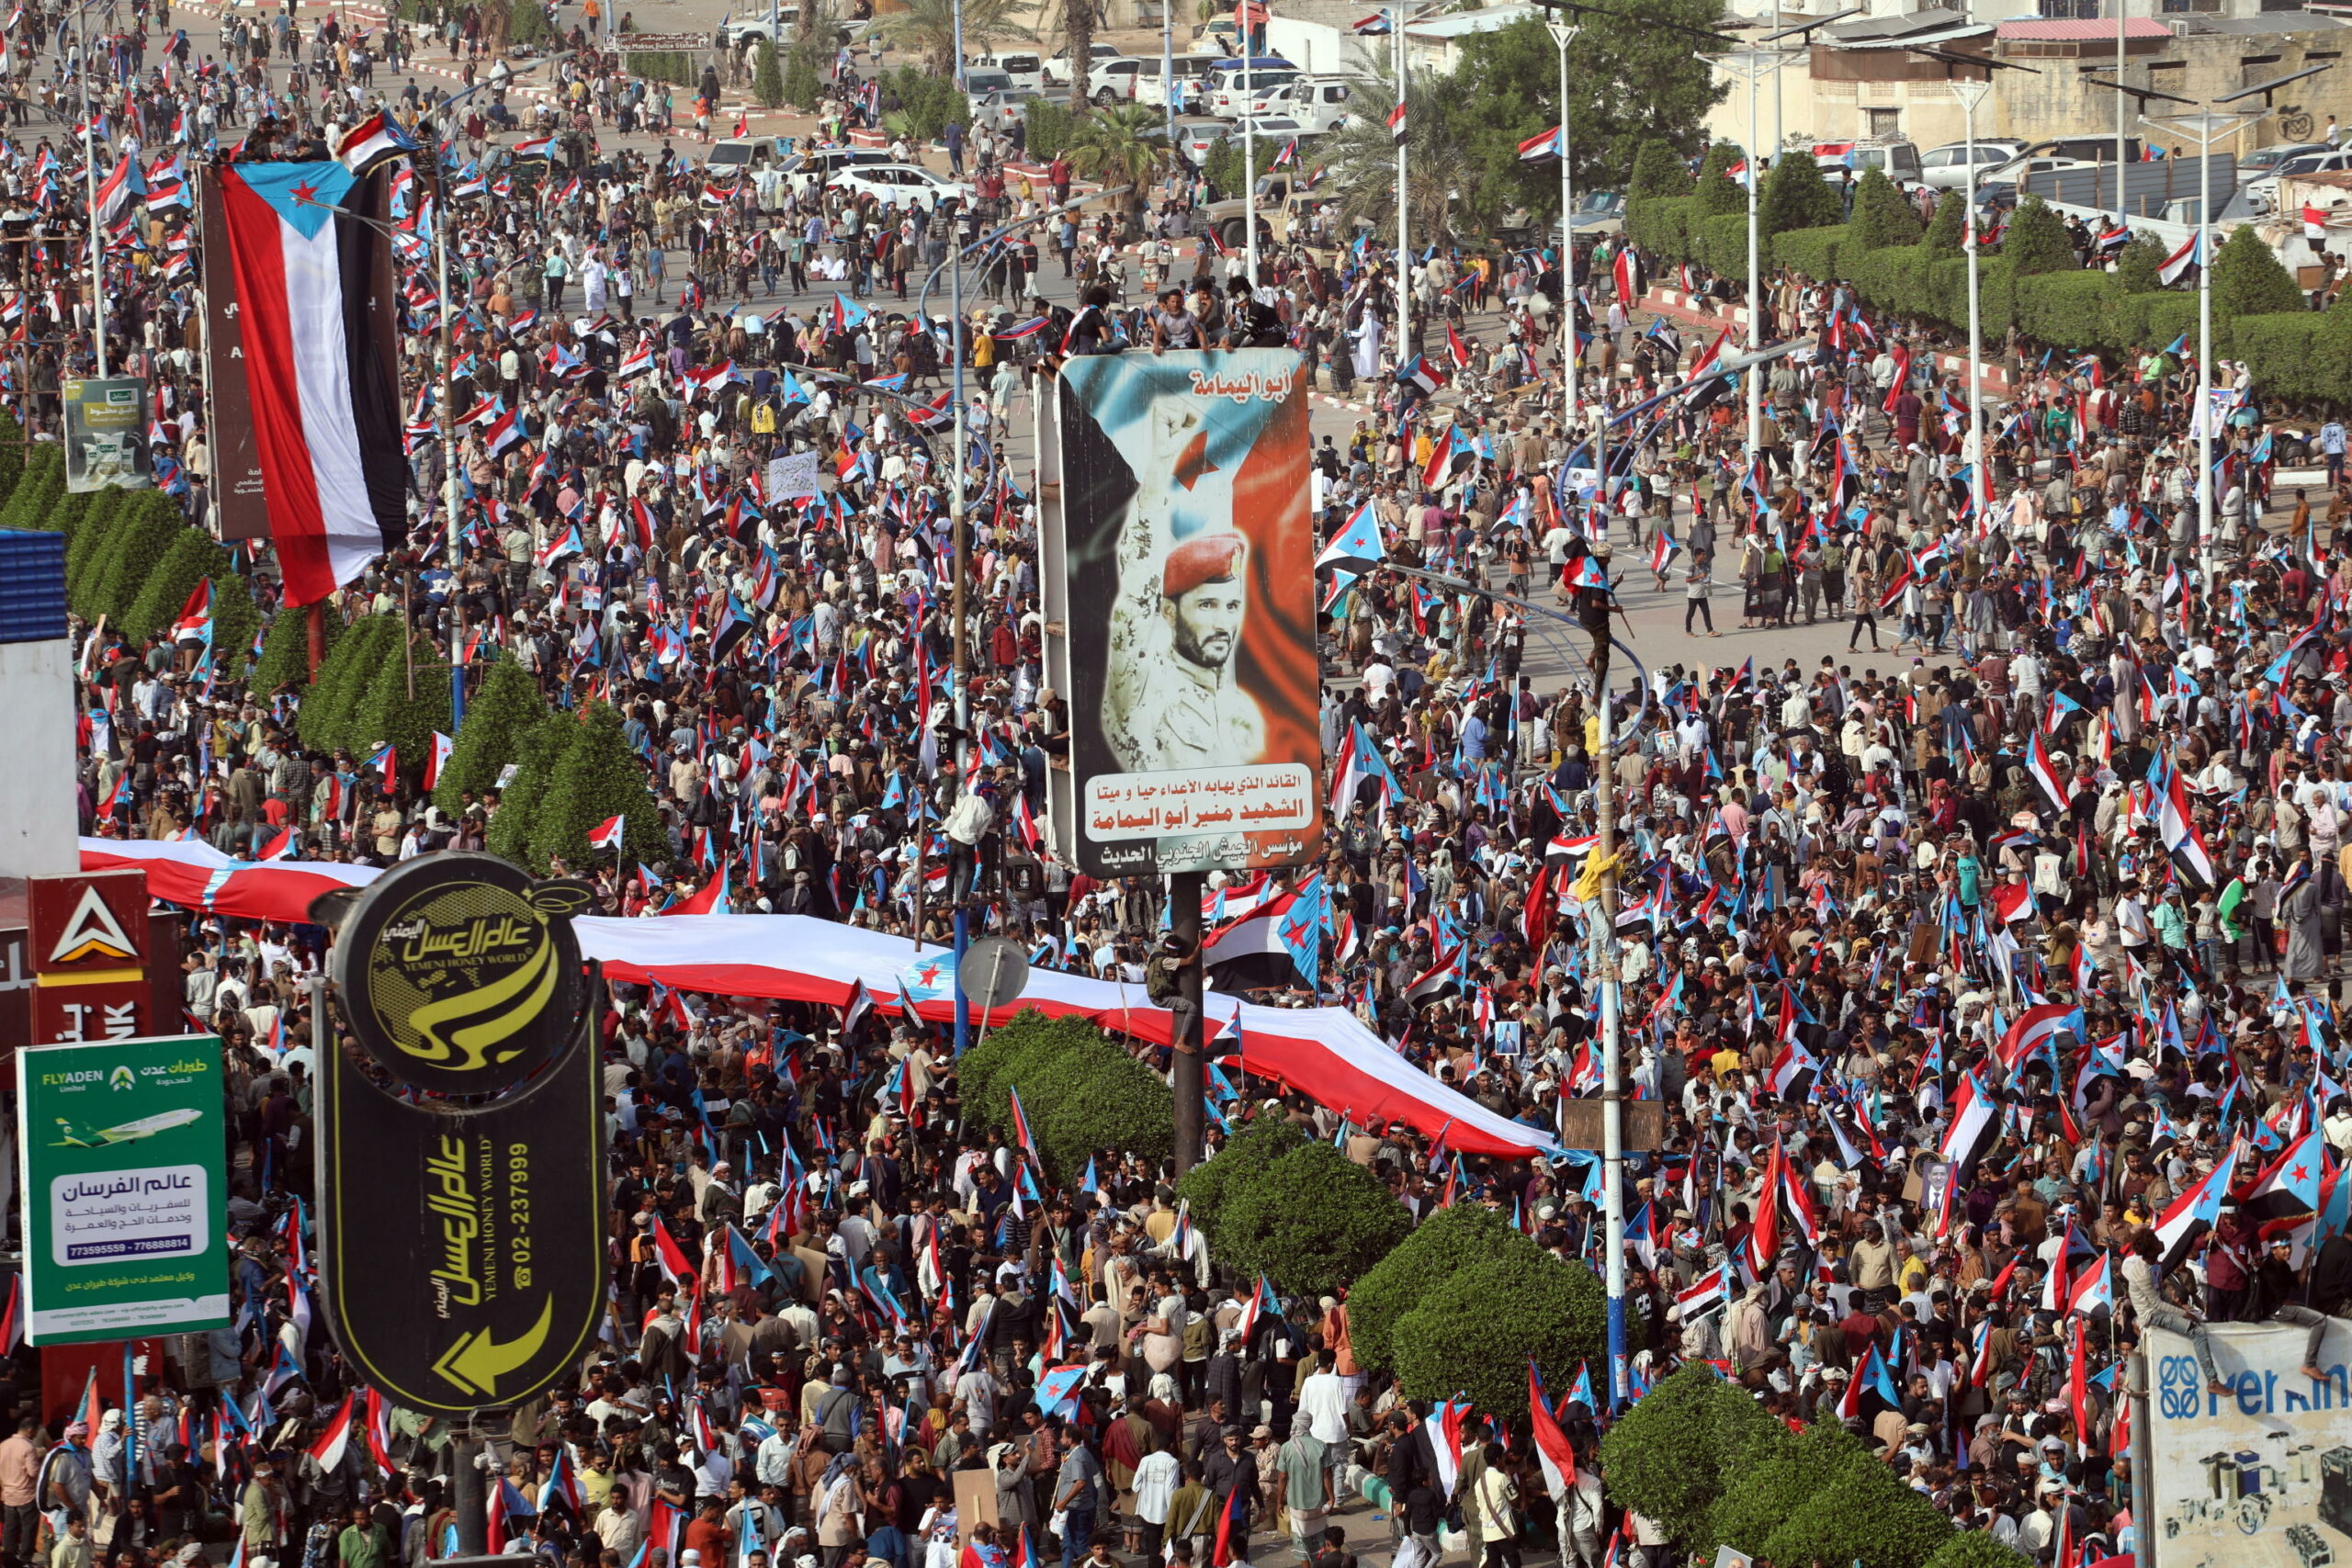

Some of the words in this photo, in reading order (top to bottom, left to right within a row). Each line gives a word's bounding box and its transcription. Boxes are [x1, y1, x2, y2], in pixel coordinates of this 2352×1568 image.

[1189, 369, 1260, 403] اليمامة
[1261, 365, 1291, 402] أبو
[1125, 788, 1131, 801] و
[1204, 779, 1236, 796] يهابه
[1238, 776, 1263, 795] الذي
[1093, 807, 1159, 831] اليمامة
[1162, 798, 1189, 829] أبو
[1192, 805, 1233, 828] منير
[1239, 798, 1303, 824] الشهيد
[1101, 845, 1152, 870] الحديث
[1155, 840, 1211, 870] الجنوبي
[1213, 837, 1258, 862] الجيش
[404, 960, 447, 972] YEMENI
[447, 955, 484, 967] HONEY
[488, 952, 527, 964] WORLD
[55, 1003, 93, 1042] بن
[104, 1000, 135, 1042] NK
[42, 1069, 104, 1086] FLYADEN
[140, 1066, 166, 1076] عدن
[167, 1058, 208, 1075] طيران
[59, 1084, 86, 1093] Limited
[481, 1139, 493, 1192] WORLD
[62, 1176, 140, 1202] الفرسان
[144, 1174, 192, 1195] عالم
[509, 1143, 531, 1263] 02-237999
[64, 1219, 118, 1234] والعمرة
[119, 1216, 144, 1230] الحج
[146, 1213, 192, 1225] وخدمات
[481, 1195, 495, 1245] HONEY
[70, 1243, 127, 1258] 773595559
[134, 1238, 188, 1251] 776888814
[482, 1246, 497, 1303] YEMENI
